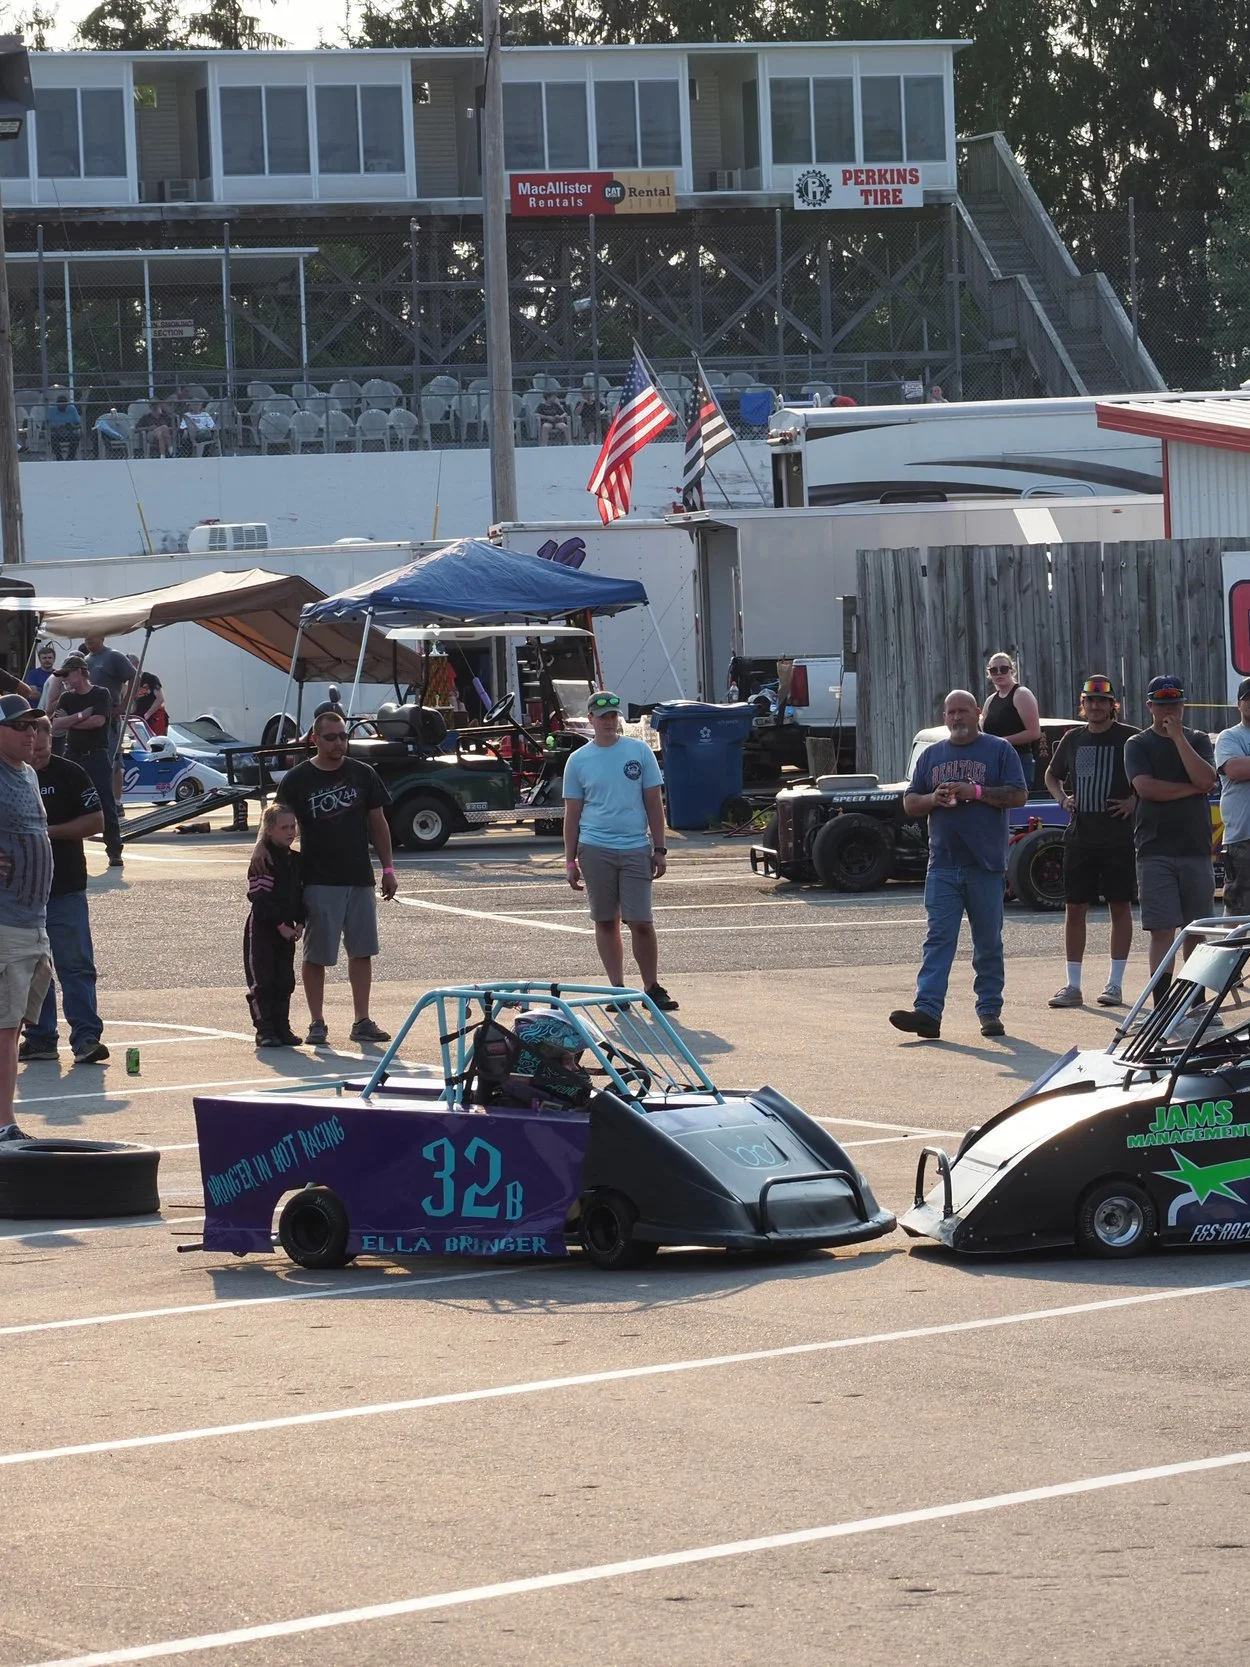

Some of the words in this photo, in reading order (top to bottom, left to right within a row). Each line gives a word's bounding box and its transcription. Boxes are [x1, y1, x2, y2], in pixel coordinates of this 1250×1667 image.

[842, 168, 920, 186] PERKINS
[518, 182, 593, 196] MacAllister
[605, 186, 621, 198] CAT
[628, 186, 671, 198] Rental
[529, 197, 583, 208] Rentals
[860, 189, 903, 206] TIRE
[153, 329, 184, 337] SECTION
[832, 794, 867, 803] SPEED
[869, 793, 900, 802] SHOP
[1149, 1100, 1234, 1133] JAMS
[252, 1153, 273, 1186] IN
[270, 1133, 300, 1173] HOT
[297, 1114, 345, 1162] RACING
[362, 1235, 432, 1253] ELLA
[445, 1235, 553, 1255] BRINGER
